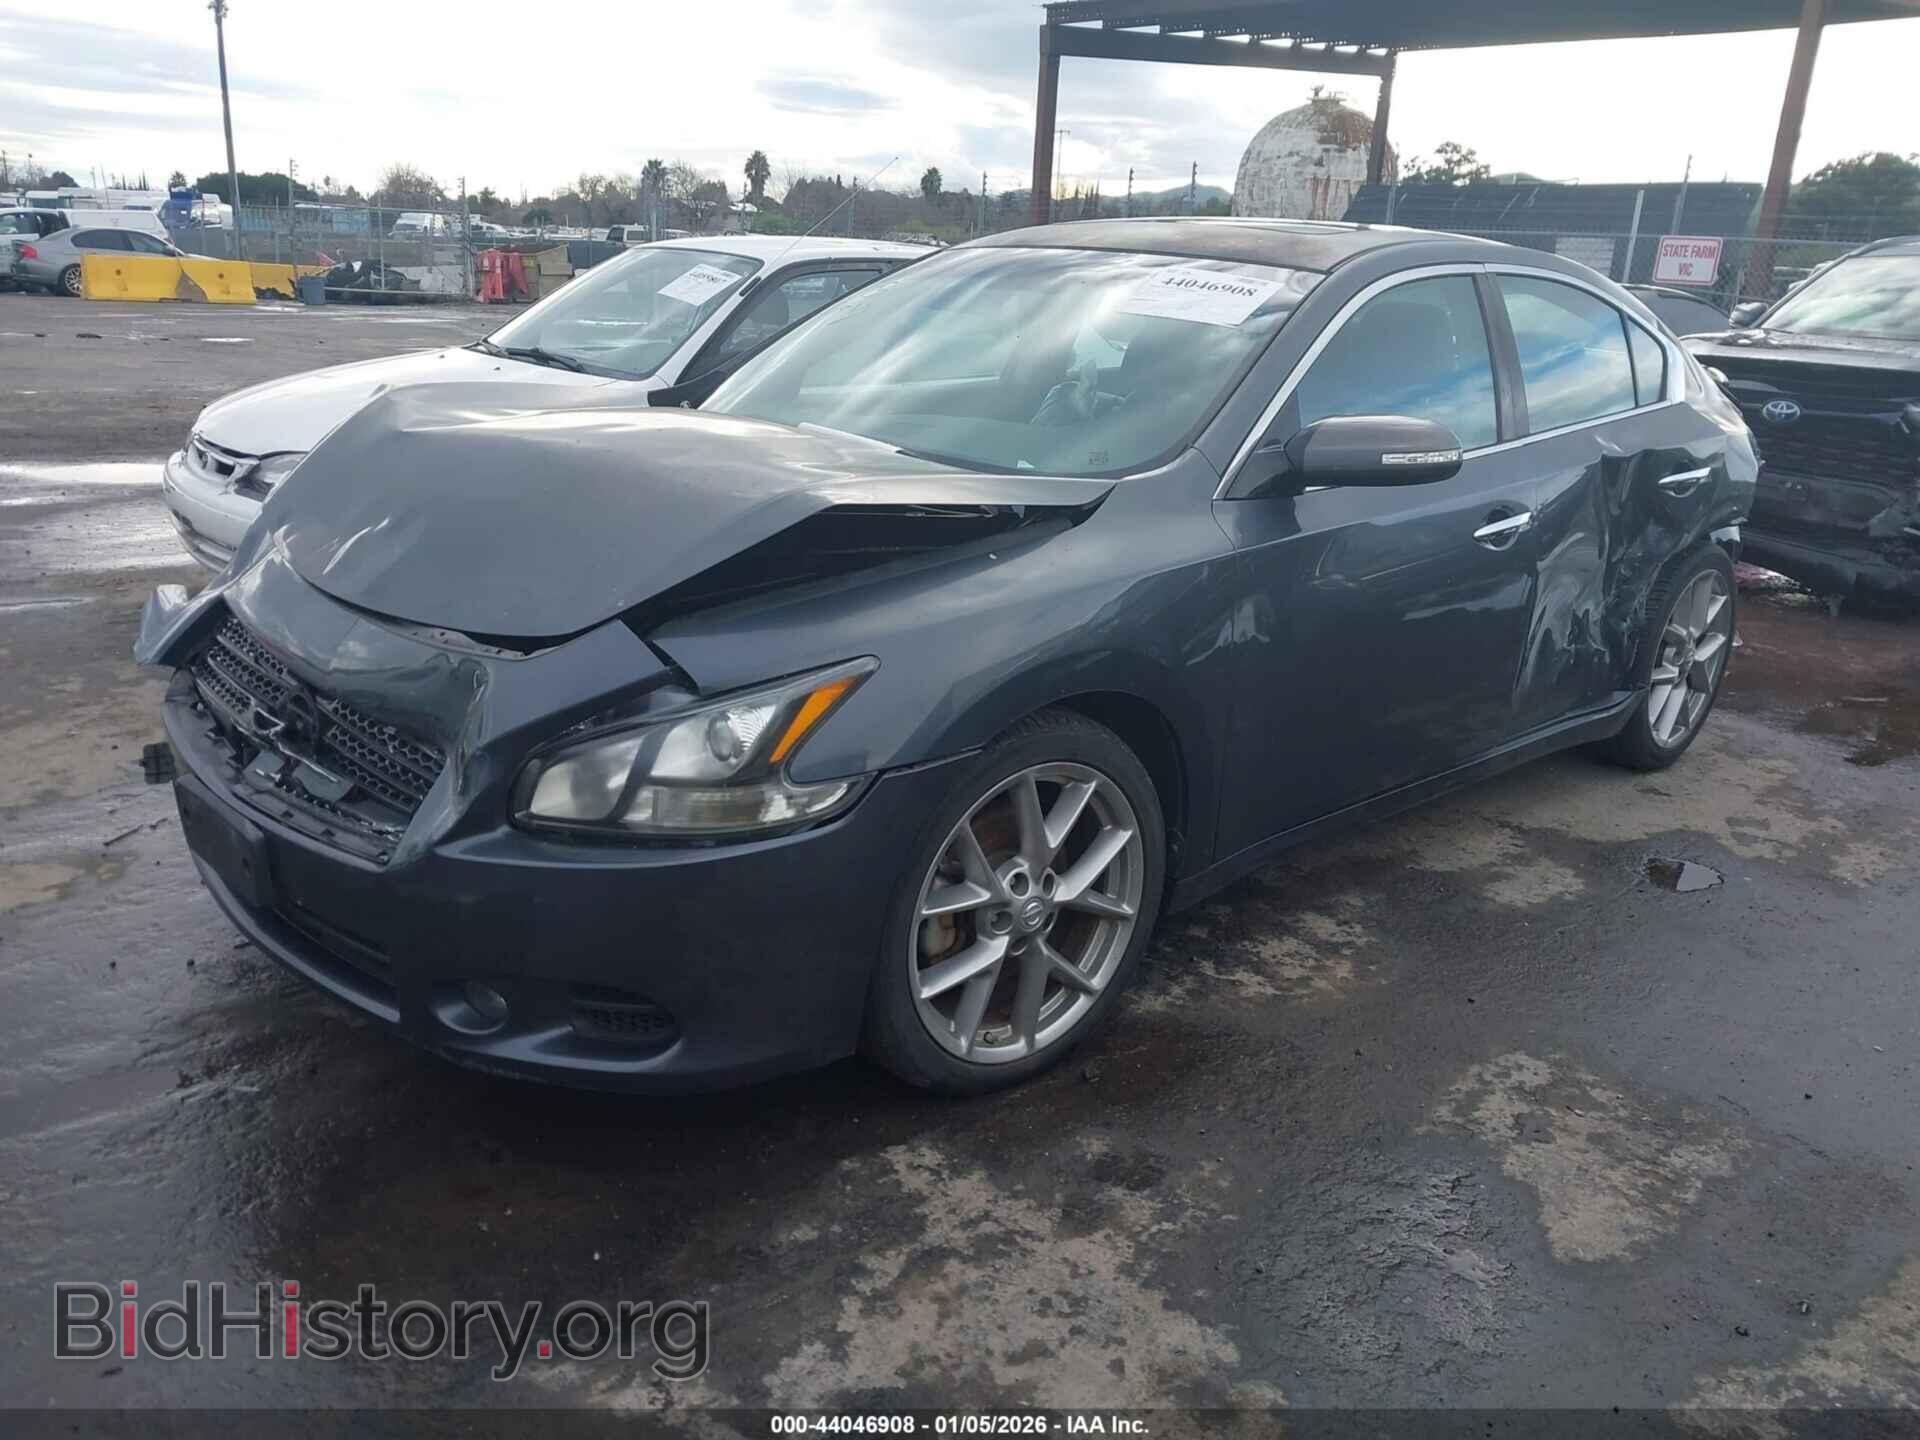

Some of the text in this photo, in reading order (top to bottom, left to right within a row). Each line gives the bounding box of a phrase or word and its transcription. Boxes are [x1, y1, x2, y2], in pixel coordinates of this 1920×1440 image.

[1663, 244, 1717, 259] STATE FARM
[1678, 262, 1695, 276] VIC
[1162, 276, 1258, 297] 44046908
